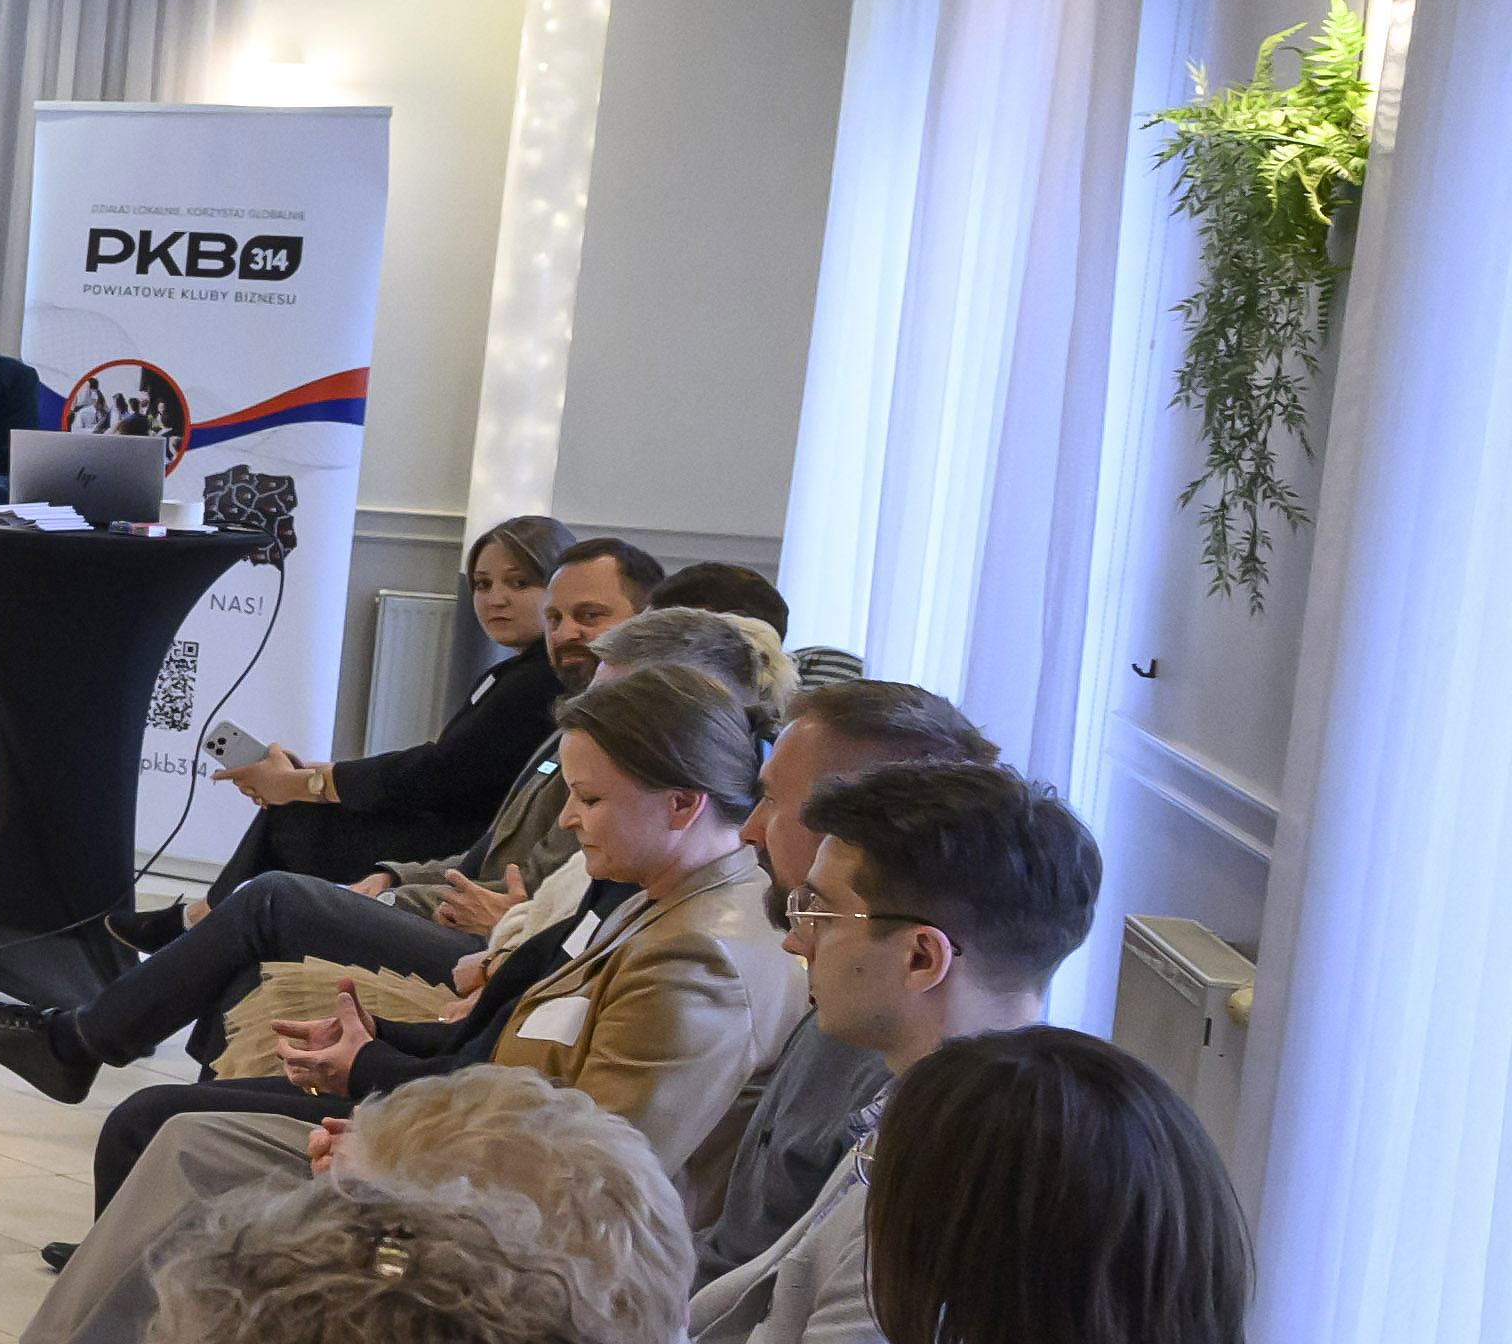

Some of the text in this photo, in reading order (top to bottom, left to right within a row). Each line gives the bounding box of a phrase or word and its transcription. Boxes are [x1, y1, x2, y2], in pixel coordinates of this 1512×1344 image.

[85, 227, 289, 279] PKB 314
[82, 283, 297, 305] POWIATOWE KLUBY BIZNESU
[210, 593, 264, 616] NAS!
